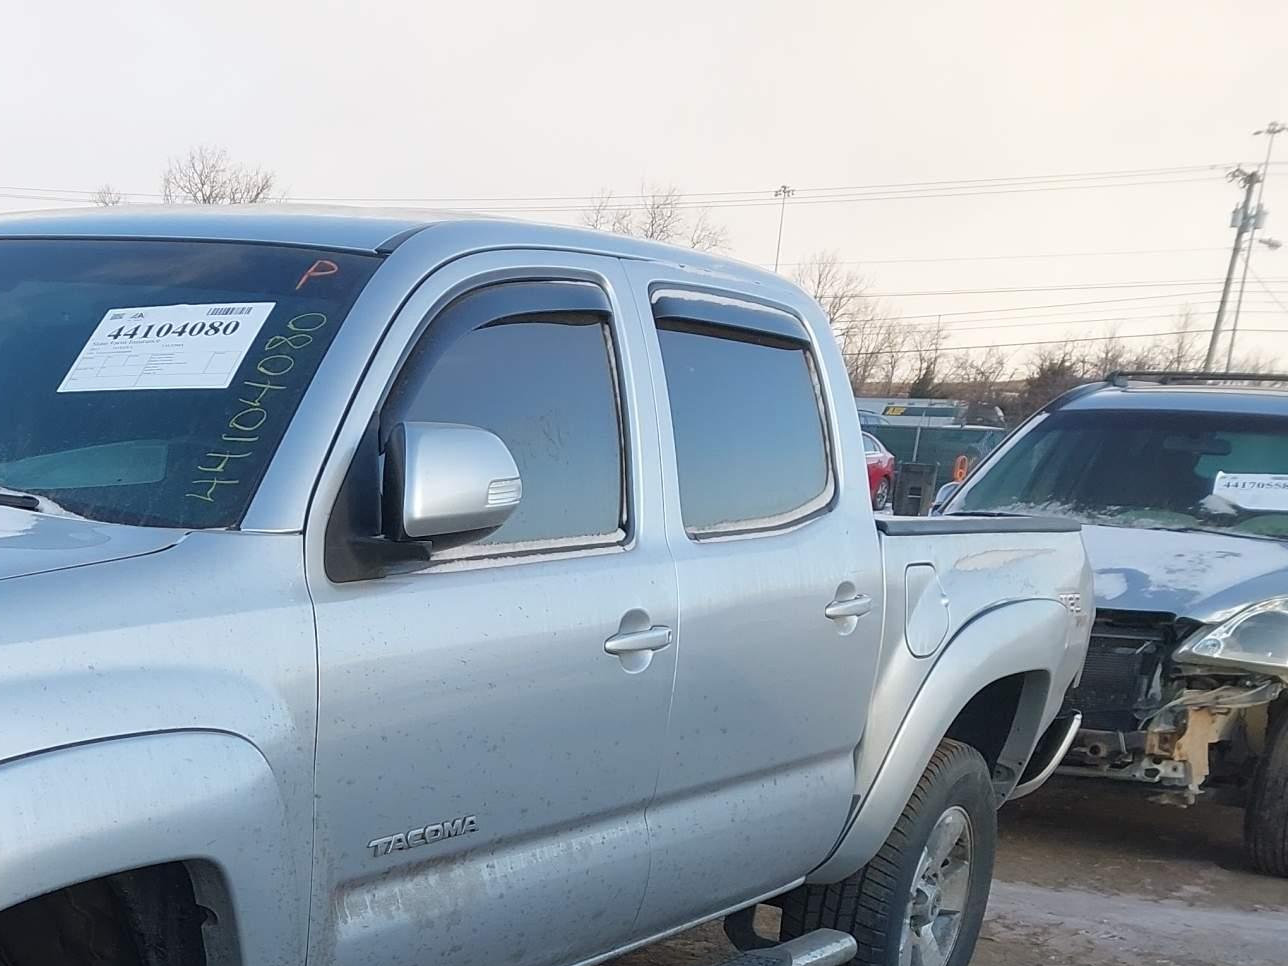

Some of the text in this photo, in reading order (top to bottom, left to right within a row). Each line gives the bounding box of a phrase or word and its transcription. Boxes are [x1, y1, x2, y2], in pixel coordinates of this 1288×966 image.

[296, 259, 338, 290] P
[107, 320, 241, 340] 44104080
[185, 312, 328, 502] 44104080
[367, 814, 479, 858] TACOMA
